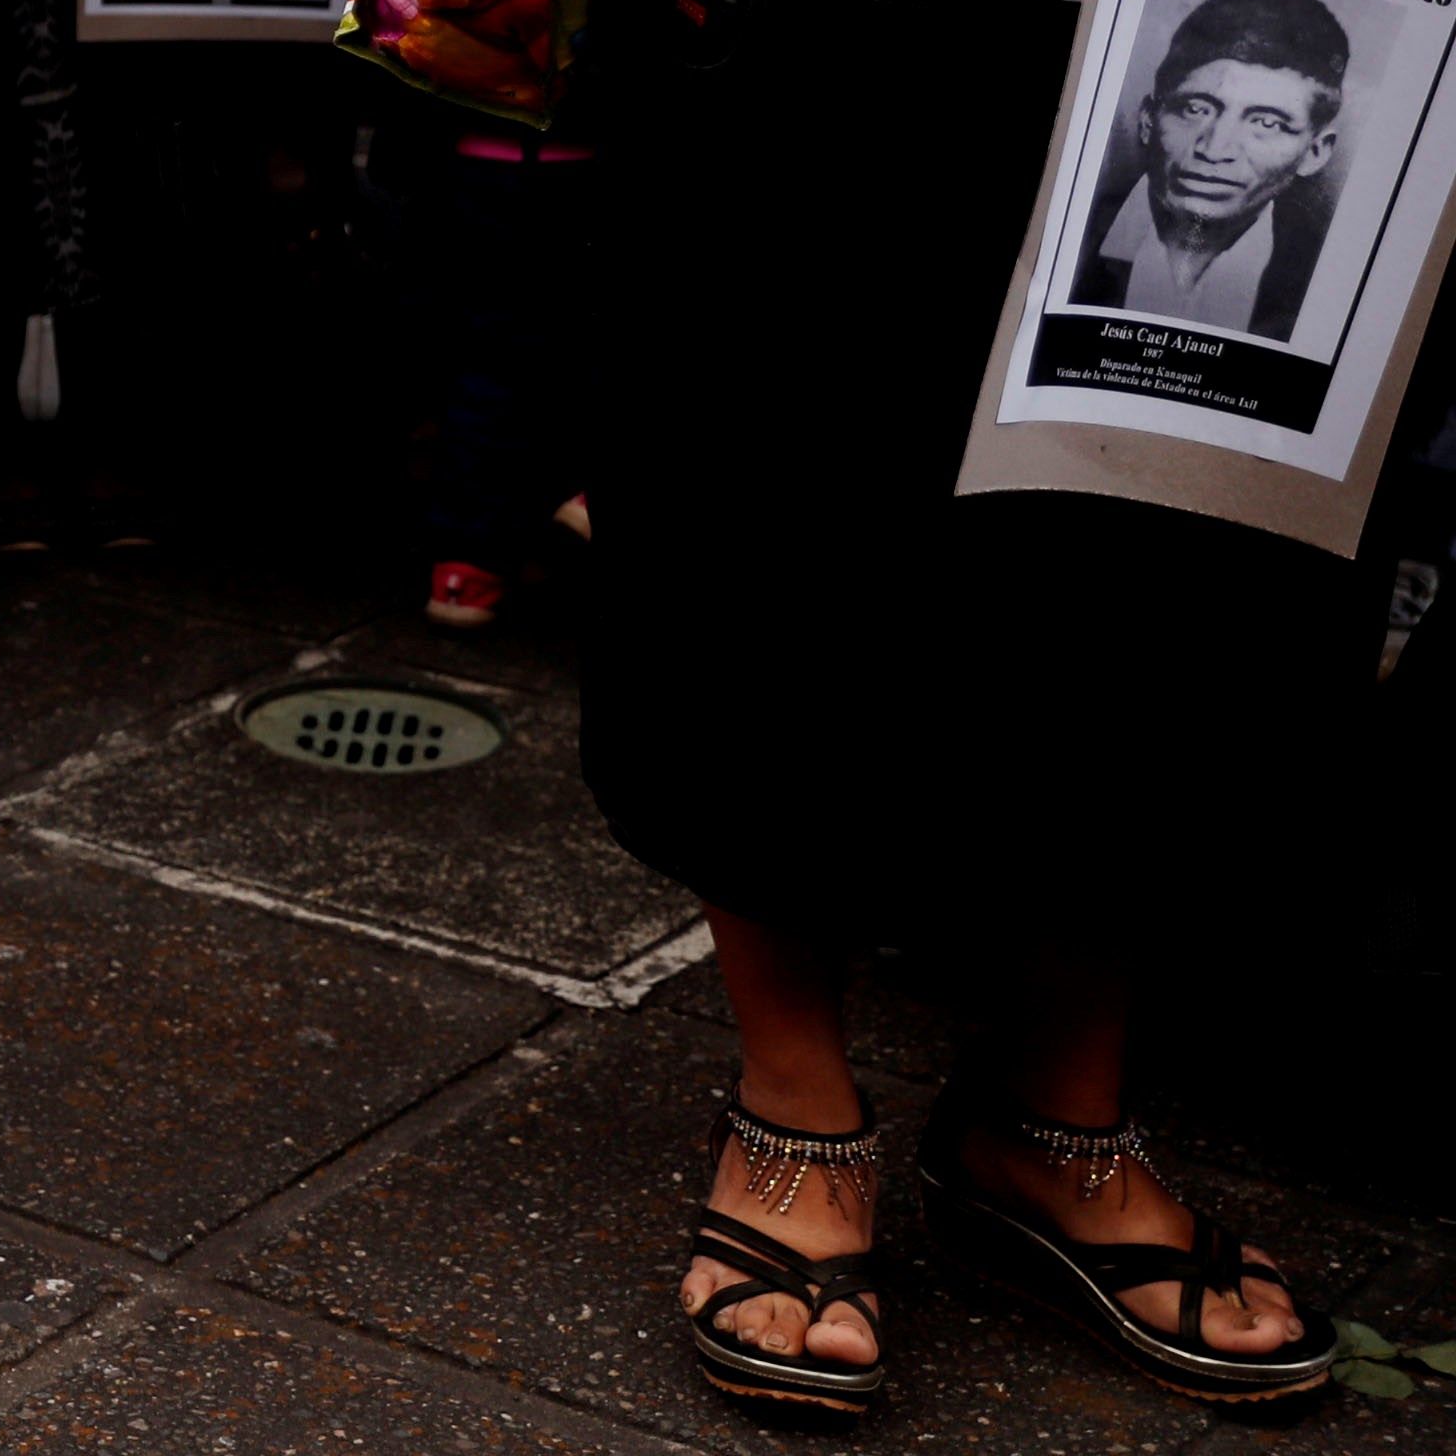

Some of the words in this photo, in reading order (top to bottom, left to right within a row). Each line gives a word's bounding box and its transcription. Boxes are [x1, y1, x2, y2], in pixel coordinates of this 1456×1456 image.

[1100, 323, 1134, 341] Jesús
[1100, 358, 1142, 374] Disparado
[1143, 365, 1154, 375] en
[1082, 369, 1092, 380] de
[1093, 370, 1101, 381] la
[1102, 371, 1139, 386] violencia
[1141, 377, 1153, 388] de
[1154, 379, 1187, 395] Estado
[1188, 387, 1200, 397] en
[1202, 389, 1212, 400] el
[1213, 392, 1236, 405] área
[1238, 396, 1259, 411] Ixil
